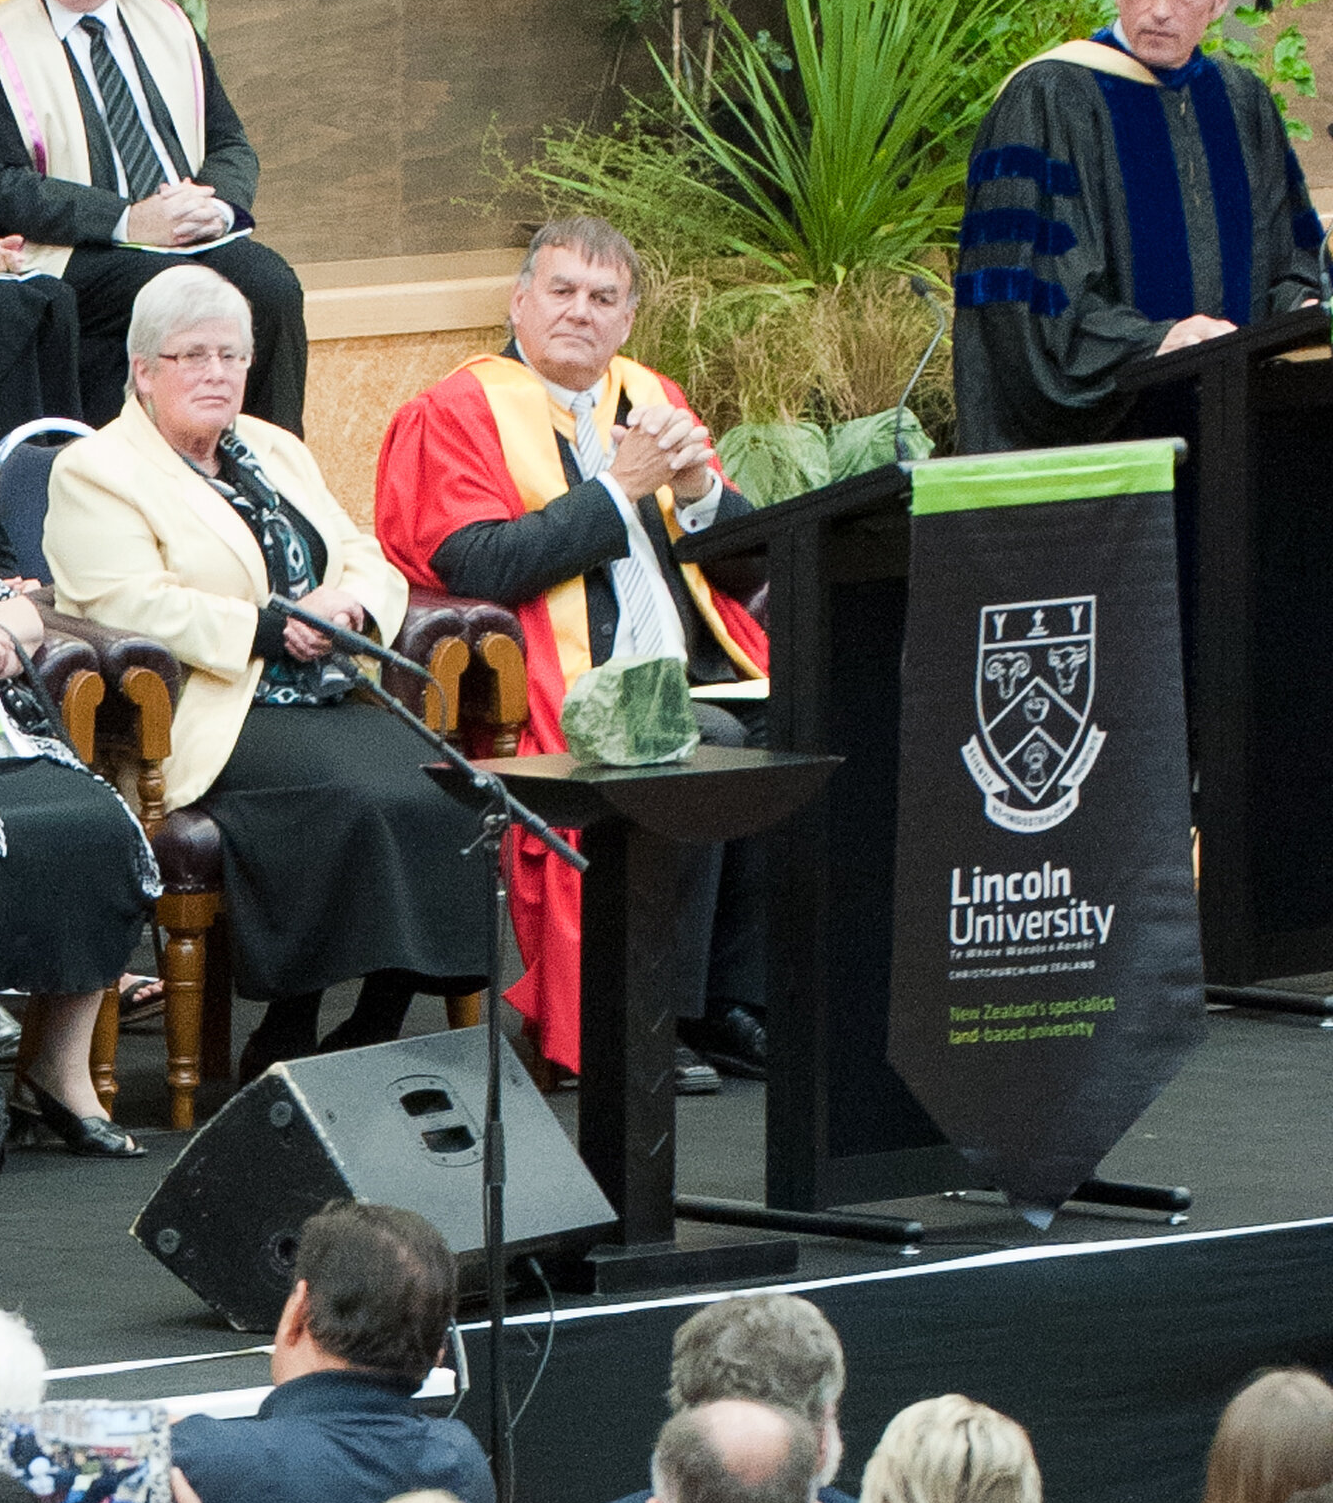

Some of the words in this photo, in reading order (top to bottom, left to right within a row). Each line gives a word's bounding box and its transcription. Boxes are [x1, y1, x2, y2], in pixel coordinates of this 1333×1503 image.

[950, 860, 1071, 905] Lincoln
[949, 898, 1115, 945] University
[949, 1006, 981, 1022] New
